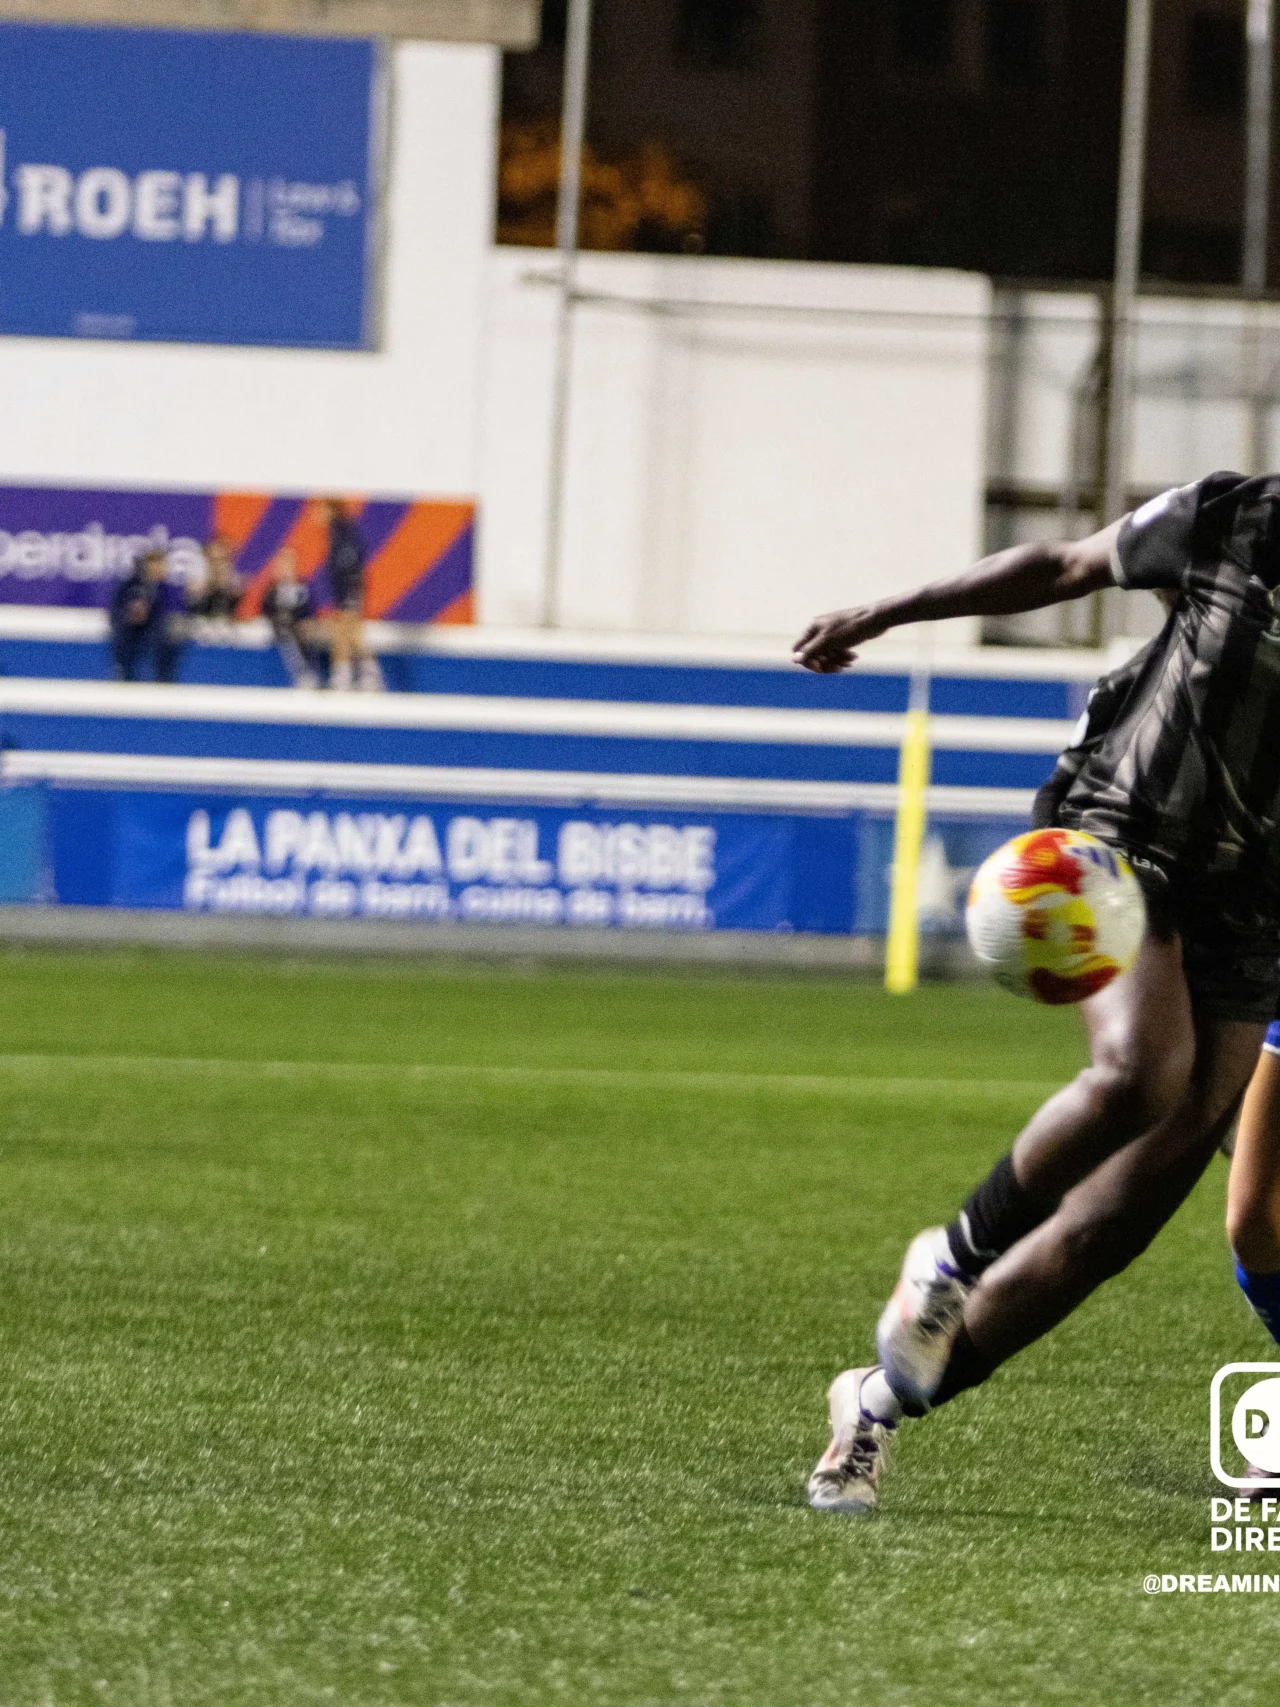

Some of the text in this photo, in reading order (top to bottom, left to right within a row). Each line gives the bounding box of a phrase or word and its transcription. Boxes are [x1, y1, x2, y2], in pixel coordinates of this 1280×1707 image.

[16, 164, 240, 244] ROEH
[186, 808, 717, 891] LA PANXA DEL BISBE
